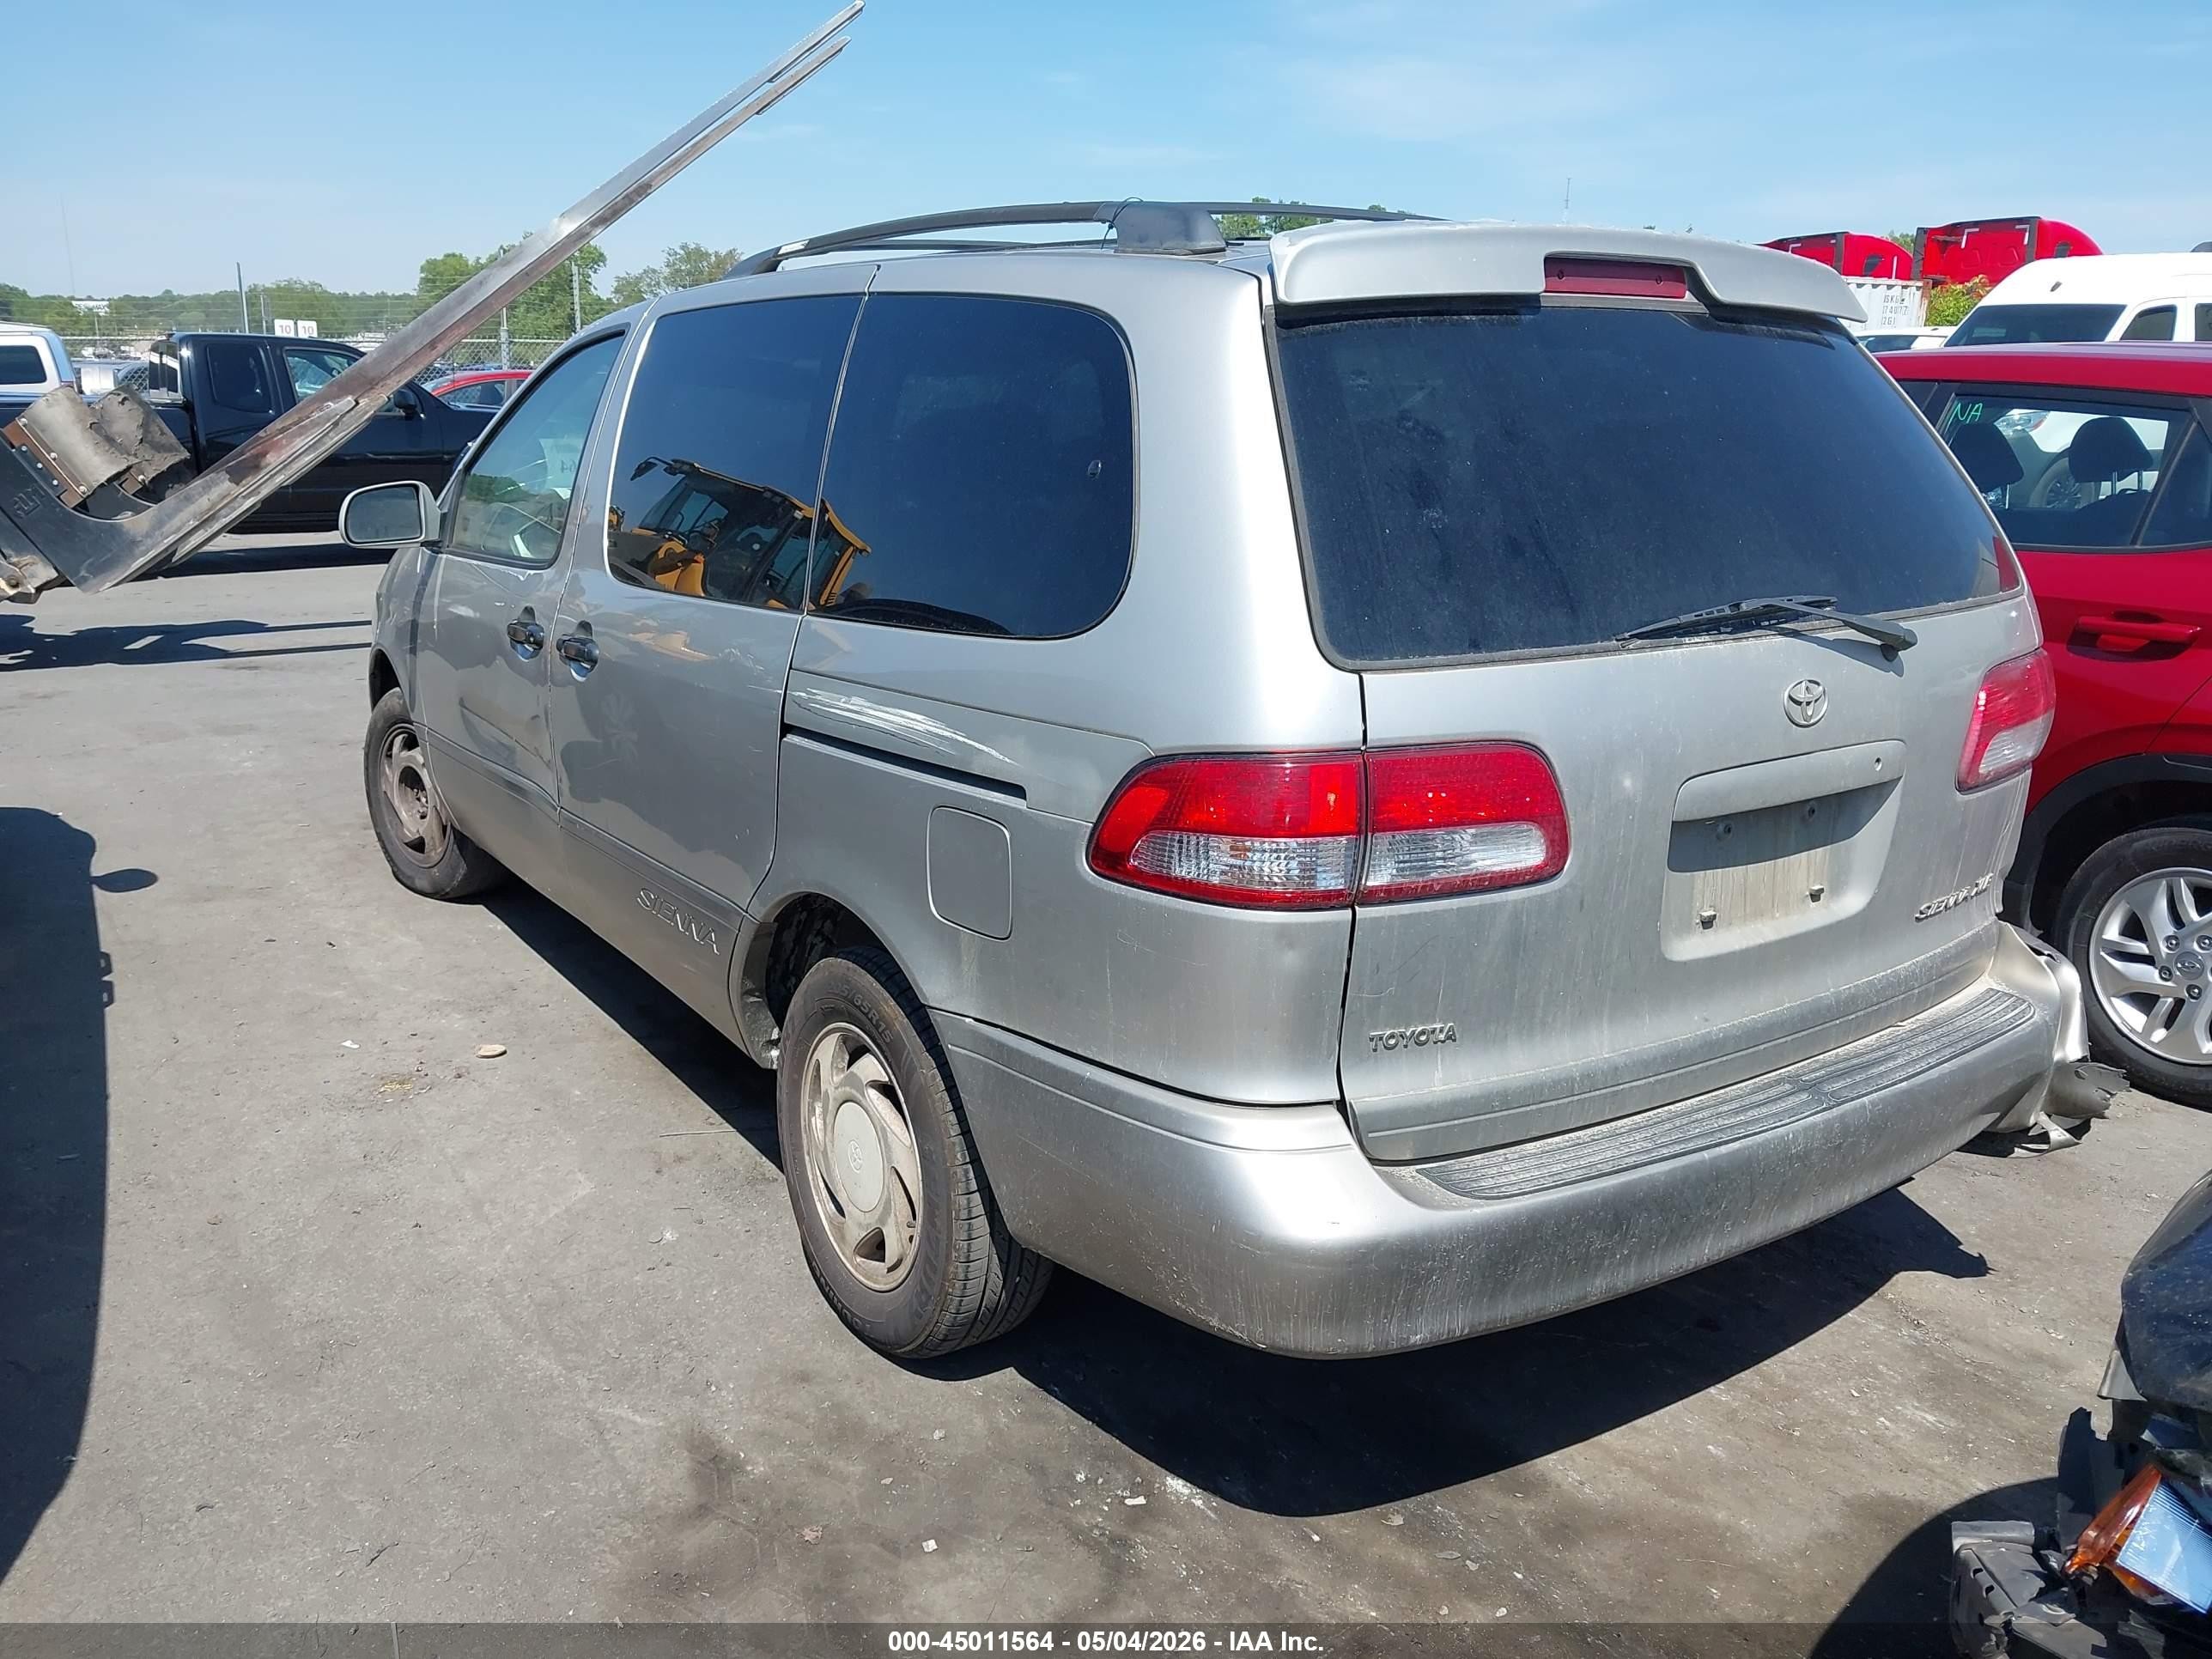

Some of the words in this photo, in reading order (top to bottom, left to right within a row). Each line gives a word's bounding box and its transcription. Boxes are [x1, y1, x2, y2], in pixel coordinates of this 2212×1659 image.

[278, 324, 292, 335] 10
[301, 325, 314, 336] 10
[1943, 402, 1983, 434] NA
[635, 887, 720, 956] SIENNA
[1369, 1023, 1457, 1053] TOYOTA
